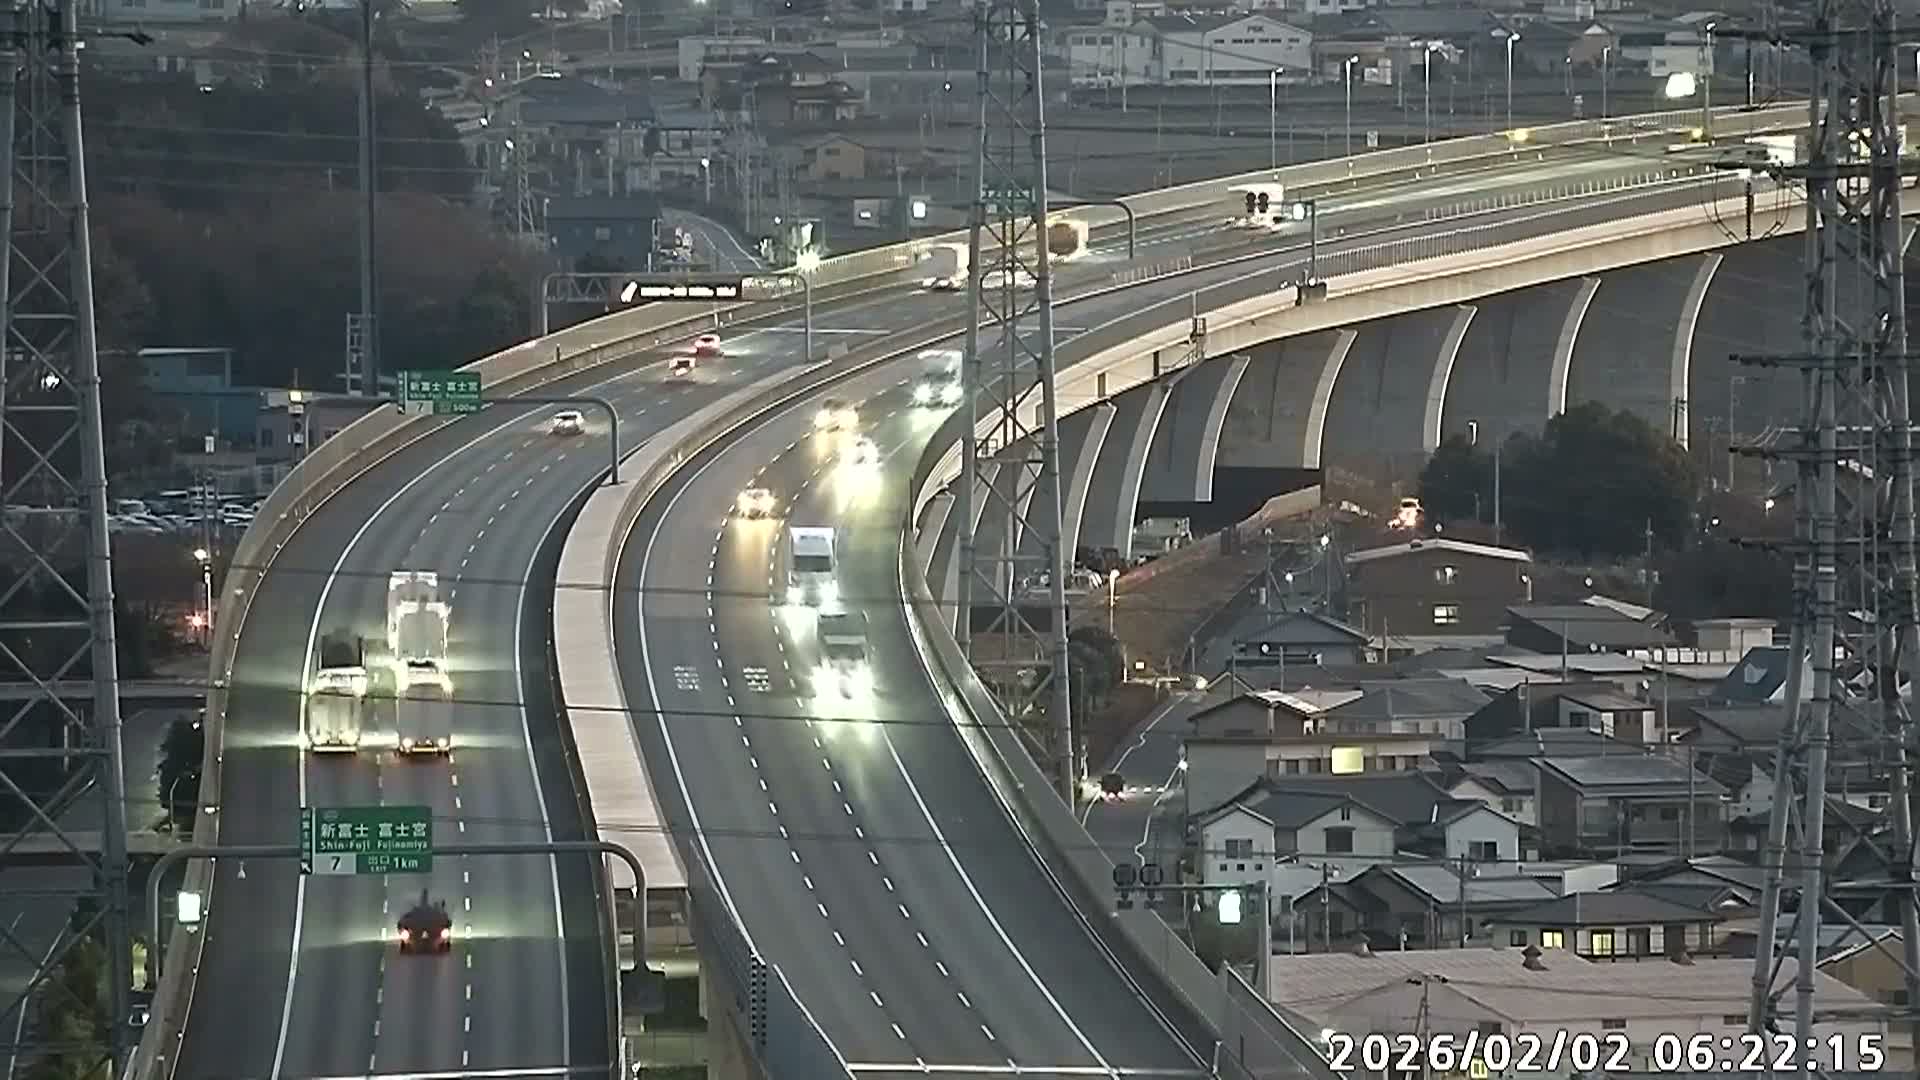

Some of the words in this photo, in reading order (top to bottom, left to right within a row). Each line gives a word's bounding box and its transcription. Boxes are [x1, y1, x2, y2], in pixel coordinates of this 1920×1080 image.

[321, 823, 369, 838] 新富士
[379, 822, 427, 838] 富士宮
[321, 840, 370, 852] Shin-Fuji
[378, 840, 428, 852] Fujinomiya
[331, 856, 341, 871] 7
[393, 857, 418, 869] 1km
